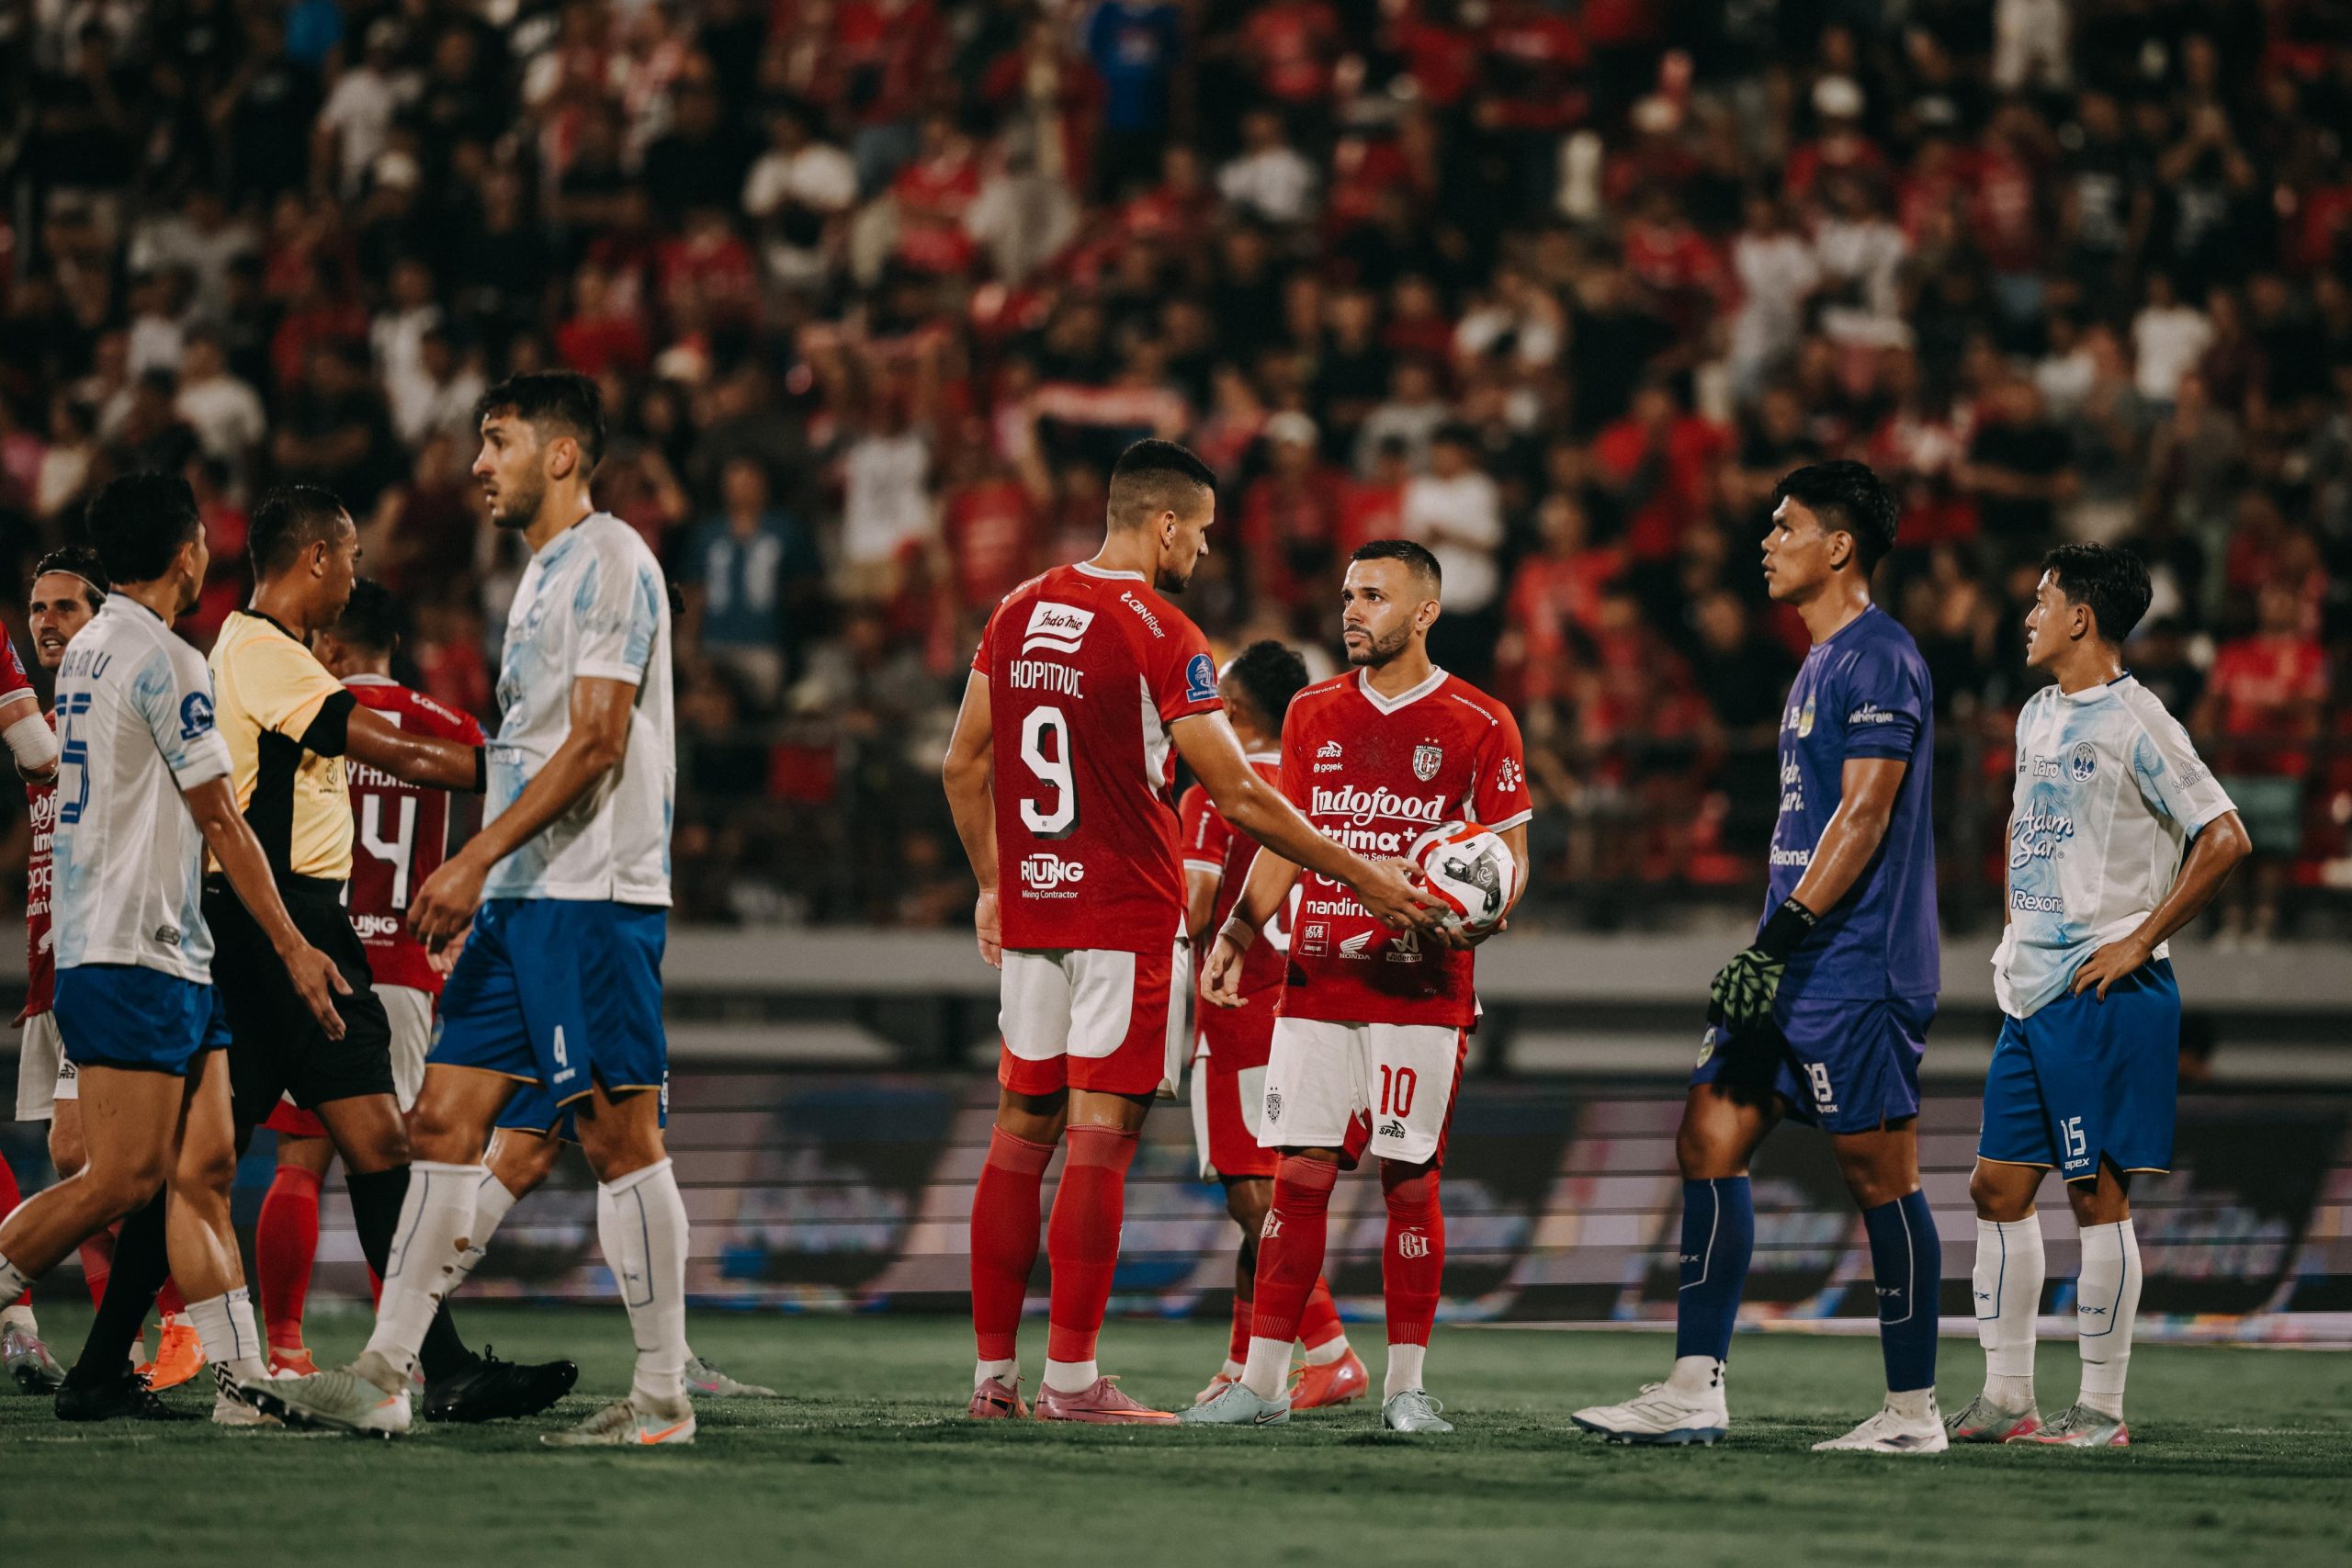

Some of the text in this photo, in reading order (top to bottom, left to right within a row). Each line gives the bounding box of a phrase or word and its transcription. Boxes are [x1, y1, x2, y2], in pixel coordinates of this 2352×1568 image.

[1317, 750, 1342, 758] SPECS
[1021, 705, 1074, 834] 9
[1320, 762, 1343, 773] gojek
[2033, 755, 2061, 779] Taro
[1310, 784, 1446, 827] Indofood
[1022, 889, 1078, 900] Mining Contractor
[1387, 952, 1420, 962] Alderon
[1380, 1064, 1418, 1119] 10
[1379, 1126, 1406, 1139] SPECS
[2060, 1116, 2086, 1158] 15
[2064, 1156, 2090, 1171] apex
